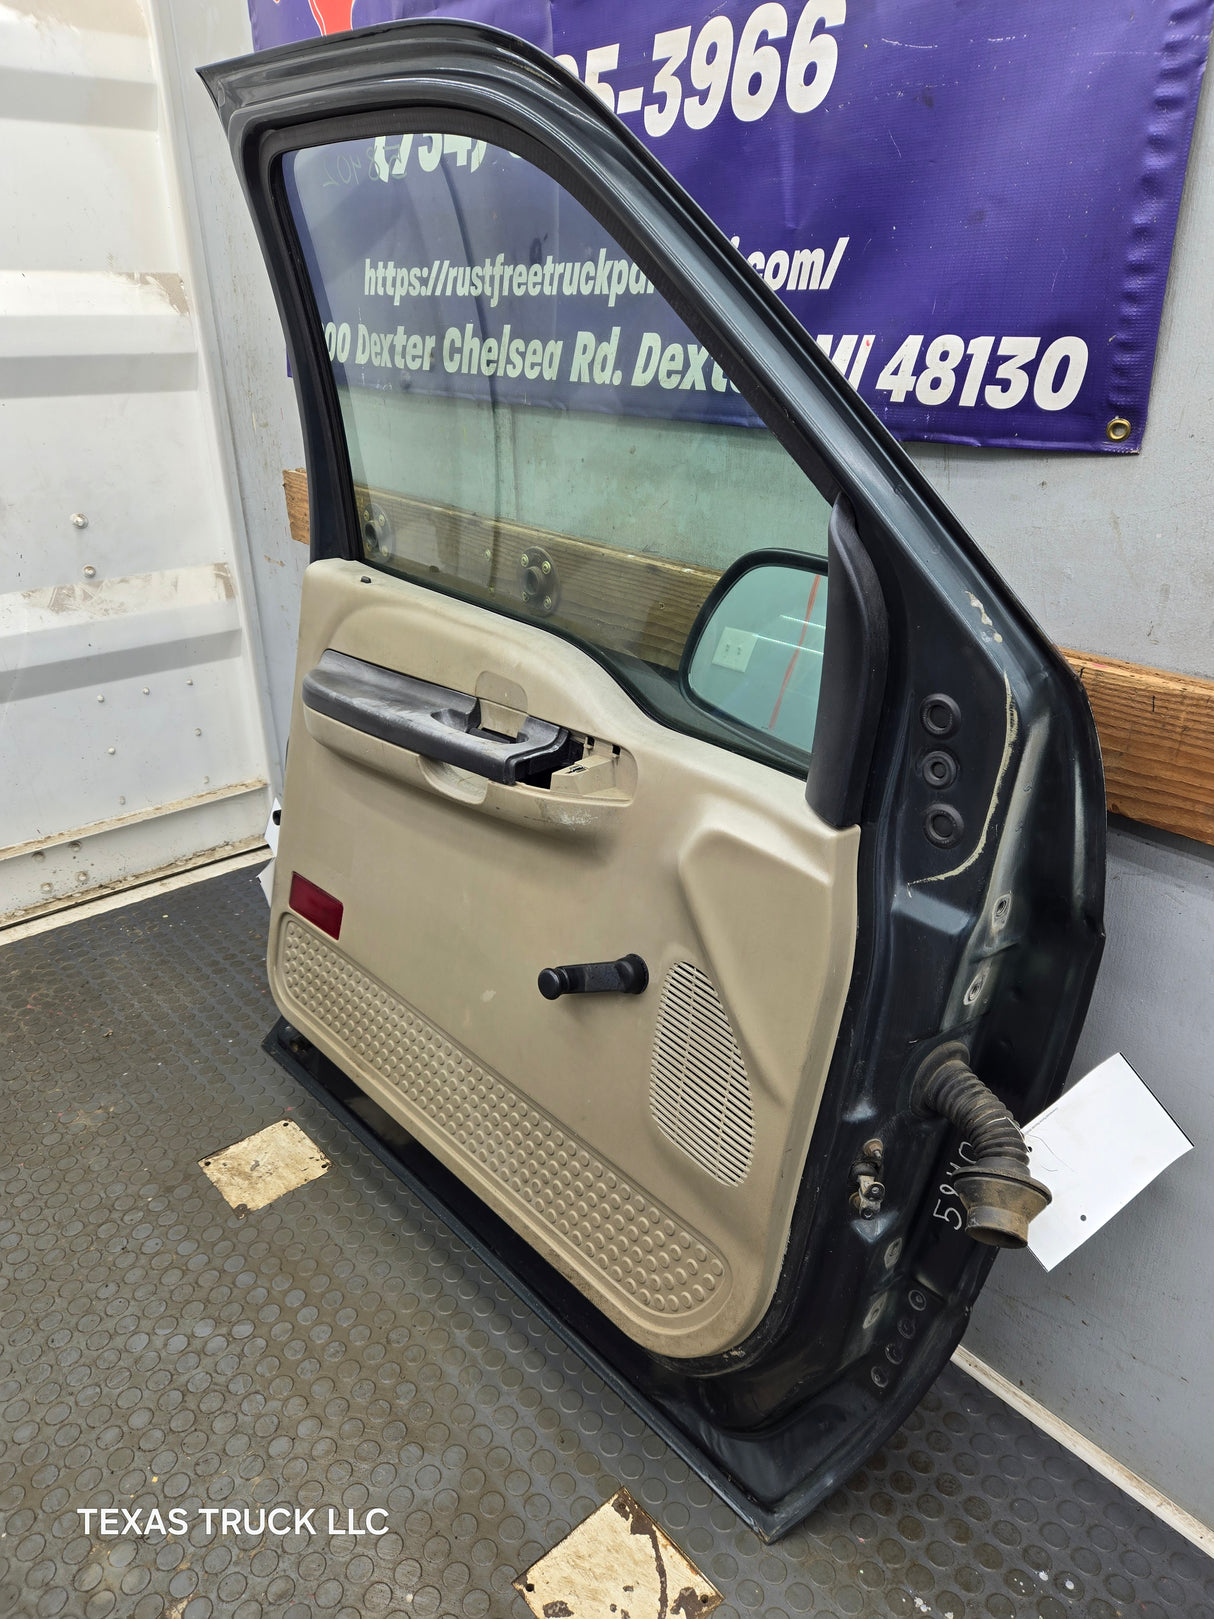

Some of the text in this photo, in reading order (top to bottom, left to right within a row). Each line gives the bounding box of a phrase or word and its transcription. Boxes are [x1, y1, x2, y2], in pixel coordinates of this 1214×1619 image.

[553, 0, 847, 138] 5-3966
[322, 321, 351, 364] 00
[355, 323, 436, 371] Dexter
[442, 323, 563, 382] Chelsea
[569, 326, 622, 386] Rd.
[631, 332, 741, 393] Dext
[875, 334, 1089, 411] 48130
